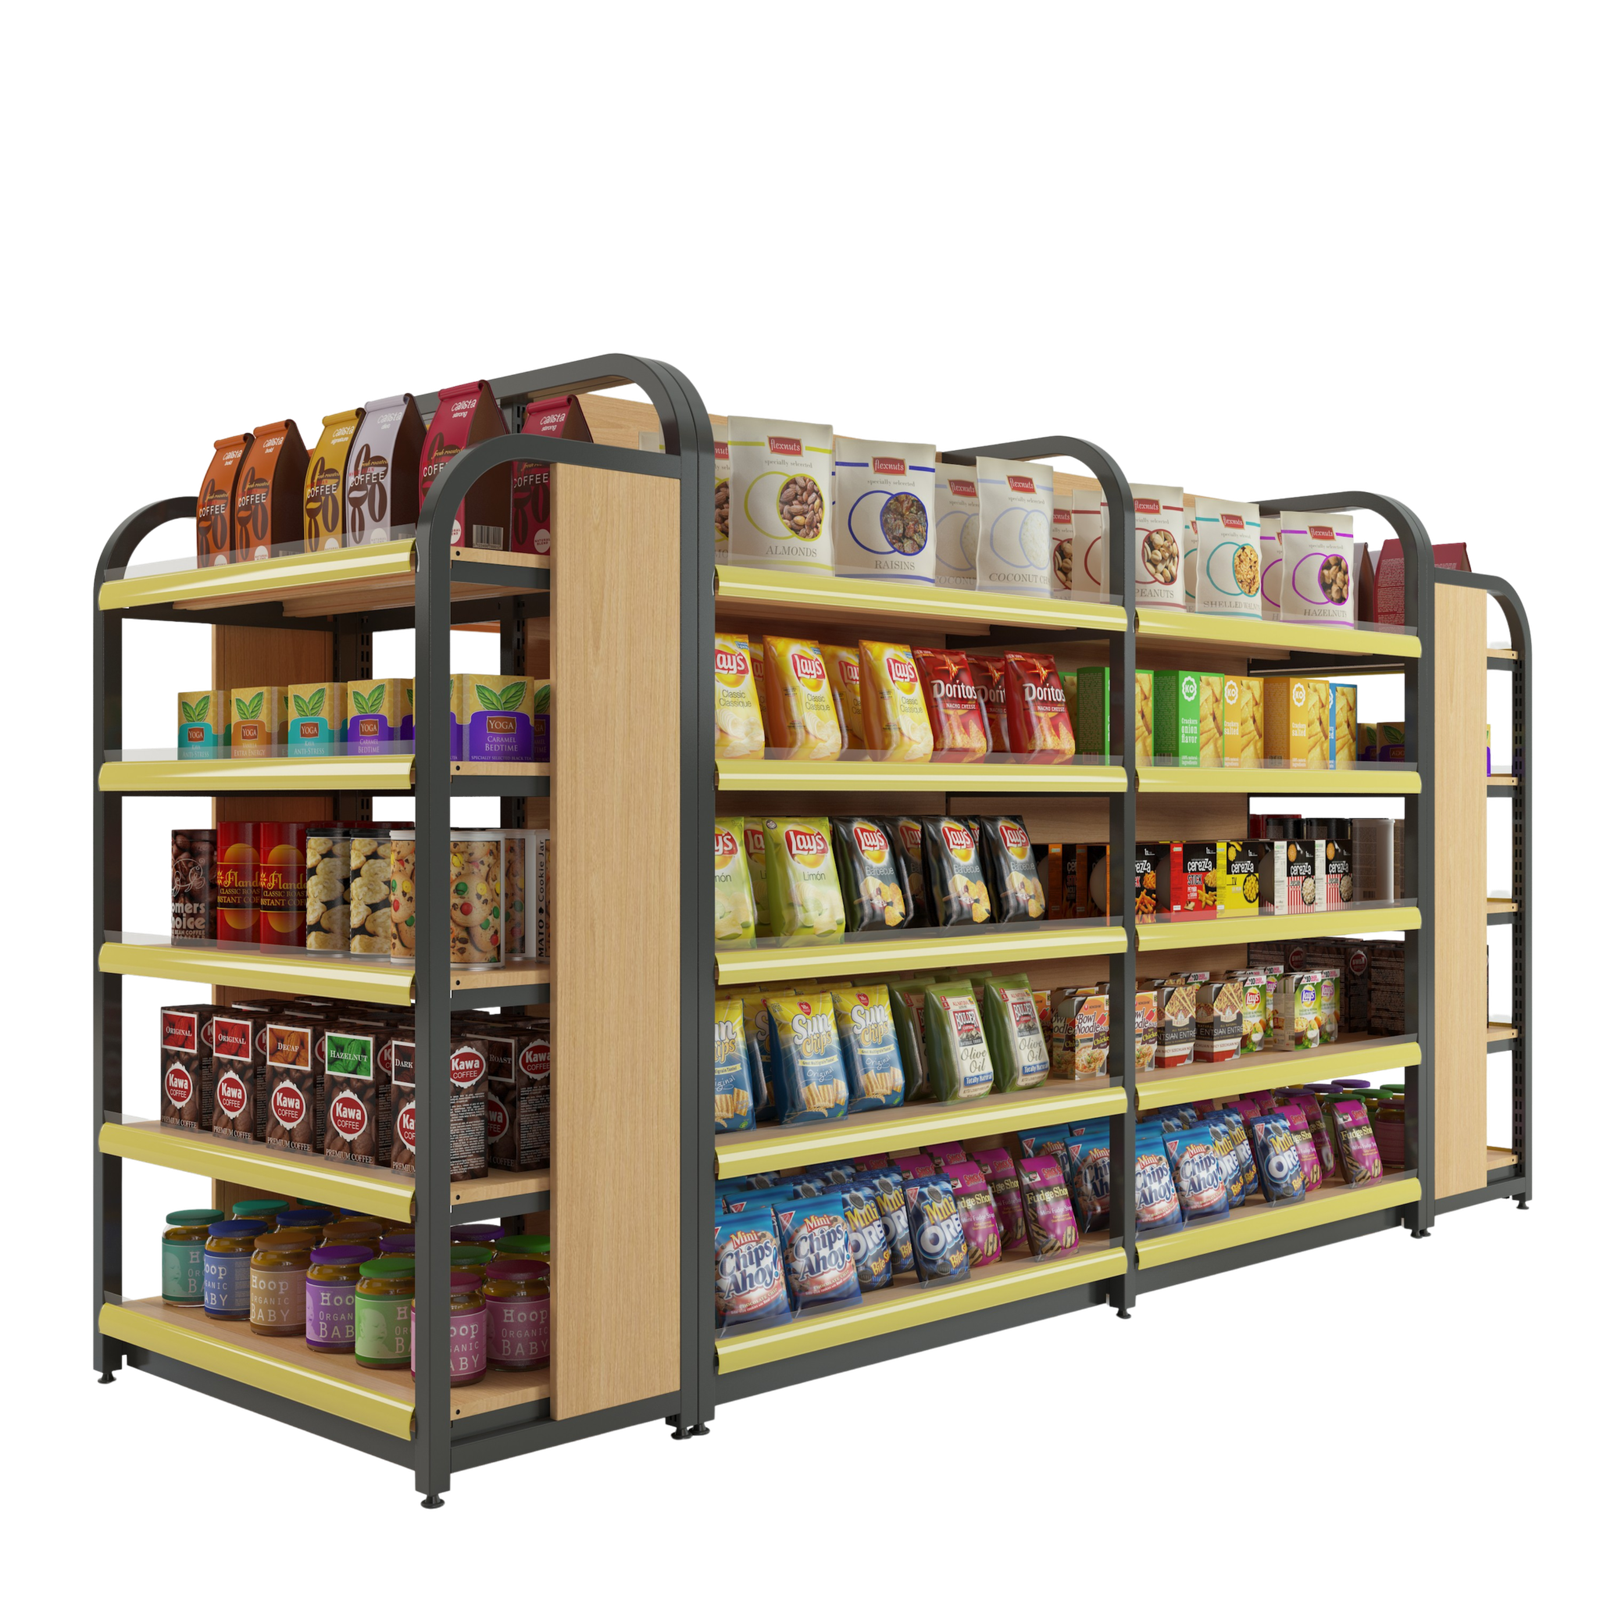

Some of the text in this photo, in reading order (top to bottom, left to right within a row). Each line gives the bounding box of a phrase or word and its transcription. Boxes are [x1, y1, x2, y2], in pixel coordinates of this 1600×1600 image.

[769, 437, 801, 452] flexnuts
[874, 459, 905, 472] flexnuts
[350, 471, 386, 487] COFFEE
[306, 483, 338, 499] COFFEE
[238, 492, 267, 507] COFFEE
[199, 504, 226, 517] COFFEE
[765, 545, 818, 558] ALMONDS
[874, 559, 916, 571] RAISINS
[989, 572, 1038, 584] COCONUT
[1203, 600, 1241, 609] SHELLED
[793, 654, 823, 679] Lay's
[888, 658, 916, 681] Lay's
[721, 689, 746, 699] Classic
[931, 680, 977, 700] Doritos
[1022, 683, 1066, 702] Doritos
[718, 698, 752, 708] Classique
[806, 693, 826, 703] Classic
[805, 701, 831, 711] Classique
[242, 727, 258, 738] YOGA
[300, 725, 318, 736] YOGA
[360, 722, 378, 733] YOGA
[488, 719, 514, 731] YOGA
[188, 728, 204, 739] YOGA
[487, 735, 516, 743] CARAMEL
[358, 745, 380, 754] BEDTIME
[485, 743, 518, 752] BEDTIME
[789, 830, 824, 855] Lay's
[856, 827, 886, 851] Lay's
[944, 826, 971, 849] Lay's
[1002, 825, 1028, 848] Lay's
[537, 840, 545, 857] Jar
[865, 865, 895, 876] Barbecue
[954, 864, 980, 874] Barbecue
[1010, 861, 1036, 871] Barbecue
[537, 861, 545, 903] Cookie
[802, 870, 826, 881] Limón
[1187, 874, 1202, 885] STICK
[851, 1004, 889, 1035] Sun
[1076, 1010, 1097, 1025] Bowl
[165, 1025, 192, 1037] ORIGINAL
[792, 1013, 832, 1045] Sun
[860, 1020, 890, 1047] Chips
[1075, 1022, 1100, 1036] Noodle
[217, 1033, 246, 1045] ORIGINAL
[802, 1031, 833, 1058] Chips
[1018, 1037, 1043, 1051] Olive
[277, 1042, 299, 1053] DECAF
[960, 1046, 987, 1061] Olive
[1026, 1048, 1043, 1062] Oil
[330, 1049, 368, 1062] HAZELNUT
[395, 1058, 414, 1068] DARK
[489, 1054, 512, 1064] ROAST
[865, 1054, 892, 1070] Original
[451, 1058, 480, 1071] Kawa
[969, 1058, 986, 1074] Oil
[168, 1073, 188, 1090] Kawa
[452, 1070, 478, 1079] COFFEE
[806, 1065, 835, 1083] Original
[169, 1088, 187, 1098] COFFEE
[221, 1082, 242, 1099] Kawa
[222, 1098, 241, 1108] COFFEE
[276, 1092, 300, 1109] Kawa
[277, 1108, 299, 1119] COFFEE
[335, 1102, 362, 1121] Kawa
[180, 1118, 197, 1129] COFFEE
[337, 1119, 360, 1130] COFFEE
[233, 1128, 252, 1140] COFFEE
[267, 1136, 311, 1152] PREMIUM COFFEE
[1186, 1143, 1207, 1159] Mini
[1269, 1134, 1294, 1154] Mini
[326, 1148, 373, 1164] PREMIUM COFFEE
[1137, 1154, 1159, 1170] Mini
[1180, 1151, 1216, 1181] Chips
[844, 1202, 879, 1232] Mini
[923, 1196, 957, 1225] Mini
[804, 1214, 831, 1232] Mini
[730, 1230, 759, 1249] Mini
[793, 1224, 844, 1260] Chips
[718, 1239, 773, 1279] Chips
[799, 1230, 851, 1282] Ahoy!
[724, 1246, 779, 1300] Ahoy!
[251, 1274, 289, 1294] Hoop
[251, 1303, 290, 1322] BABY
[503, 1308, 548, 1324] Hoop
[501, 1327, 548, 1338] ORGANIC
[501, 1339, 549, 1356] BABY
